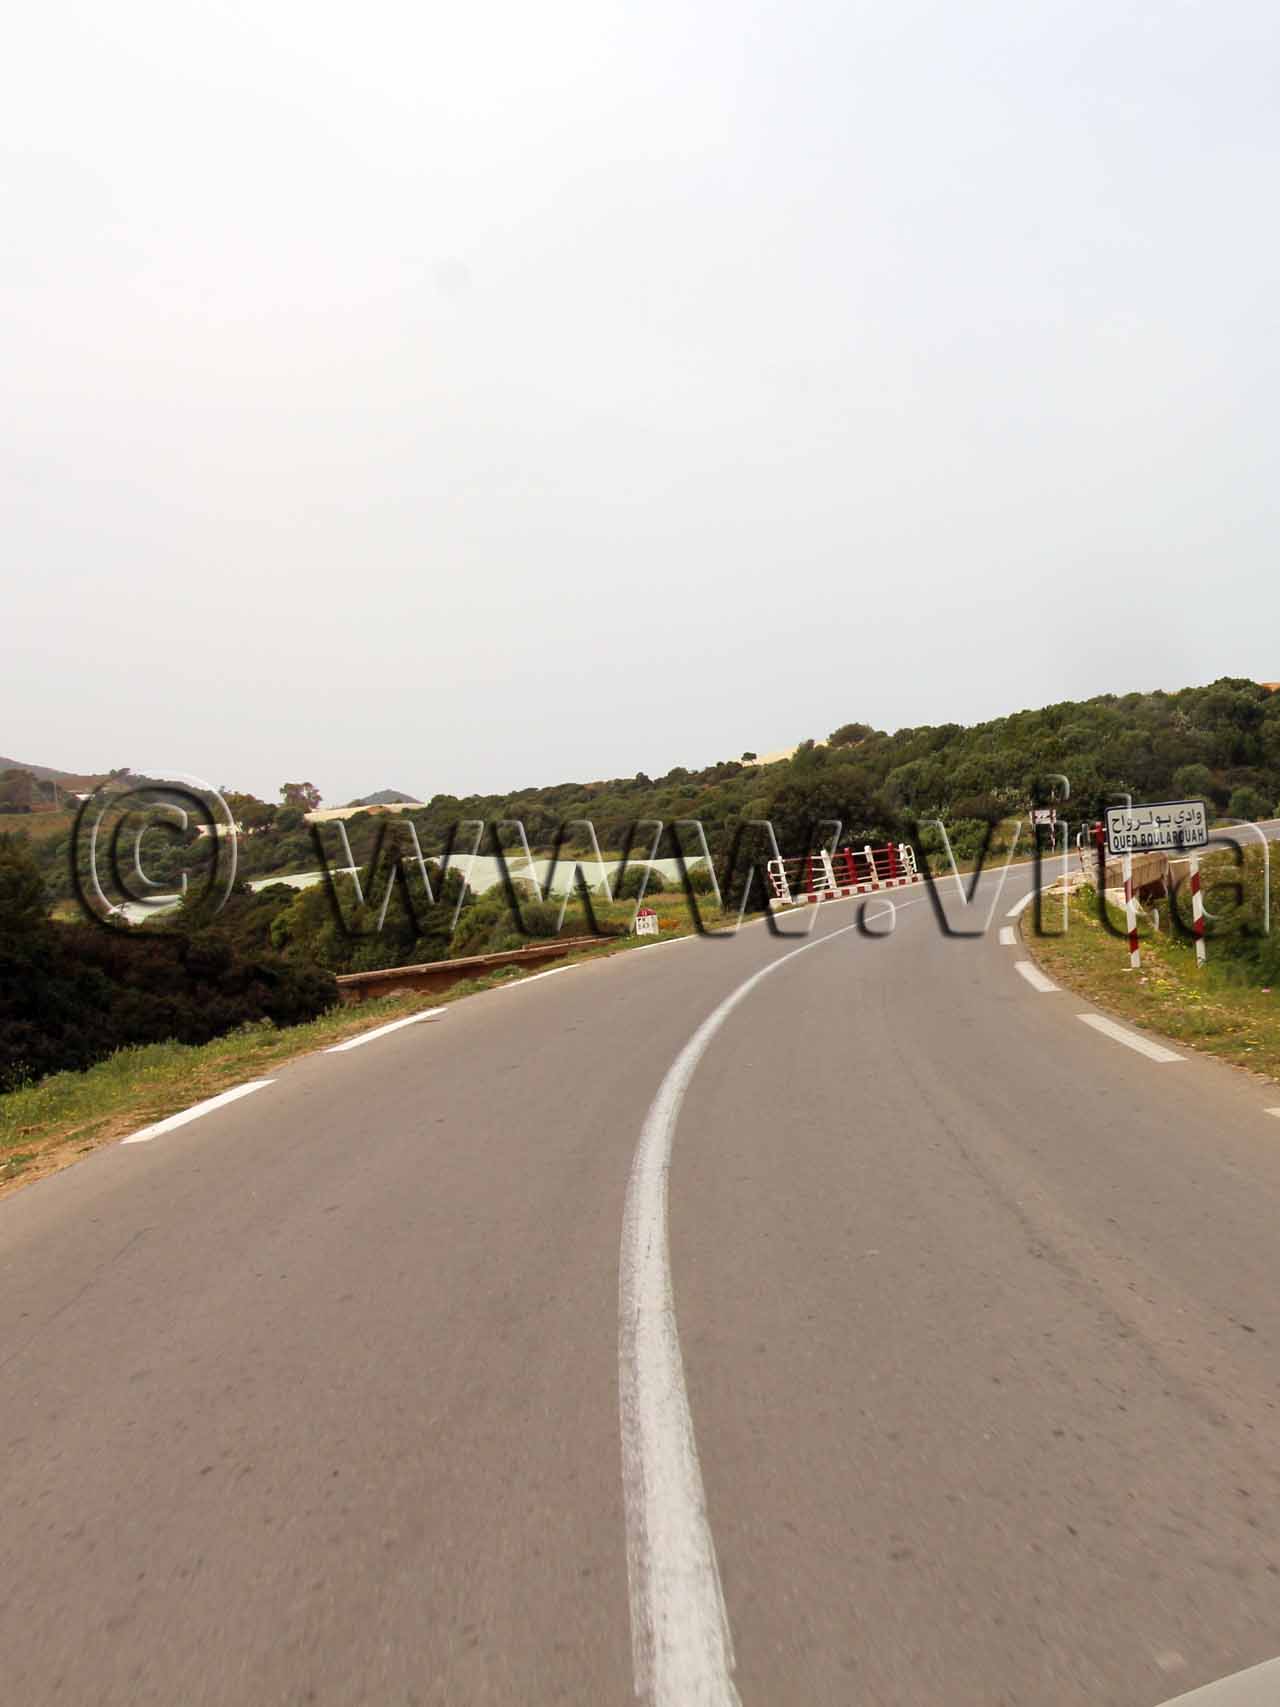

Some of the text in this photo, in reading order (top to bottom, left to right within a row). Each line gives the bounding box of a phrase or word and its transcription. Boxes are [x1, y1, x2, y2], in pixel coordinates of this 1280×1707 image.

[1174, 808, 1202, 828] وادي
[1113, 829, 1205, 849] OUED BOULAROUAH
